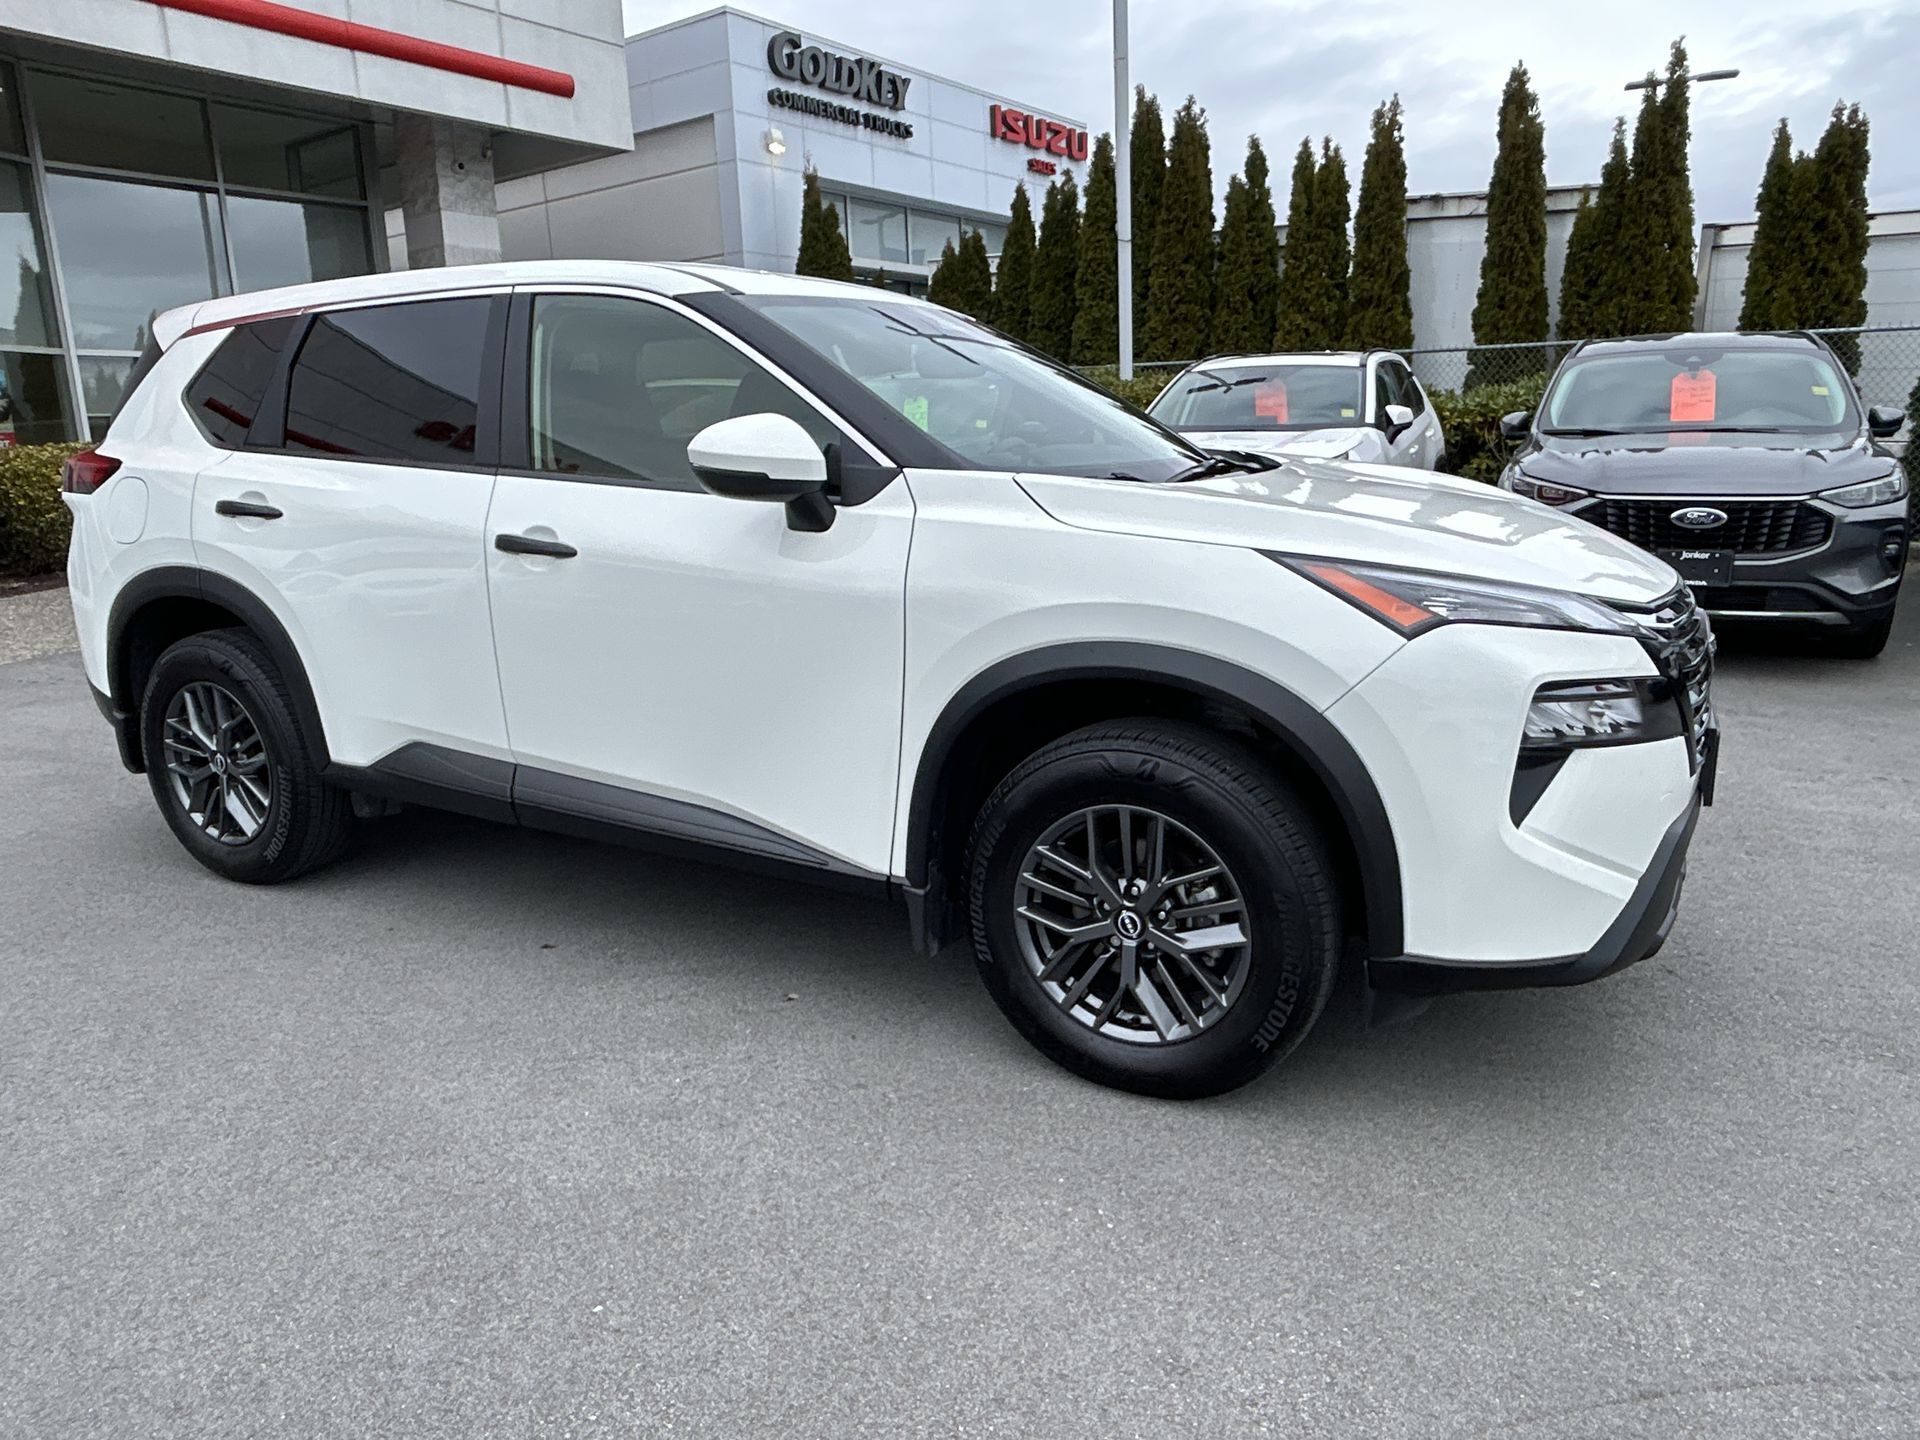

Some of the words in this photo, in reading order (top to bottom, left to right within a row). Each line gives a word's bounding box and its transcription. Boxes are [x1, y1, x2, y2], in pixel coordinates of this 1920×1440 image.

[767, 87, 862, 126] COMMERCIAL
[861, 112, 914, 139] TRUCKS
[989, 103, 1088, 161] ISUZU
[1683, 511, 1716, 525] Ford
[1679, 550, 1711, 560] Jonker
[262, 764, 294, 864] BRIDGESTONE
[969, 819, 1009, 964] BRIDGESTONE
